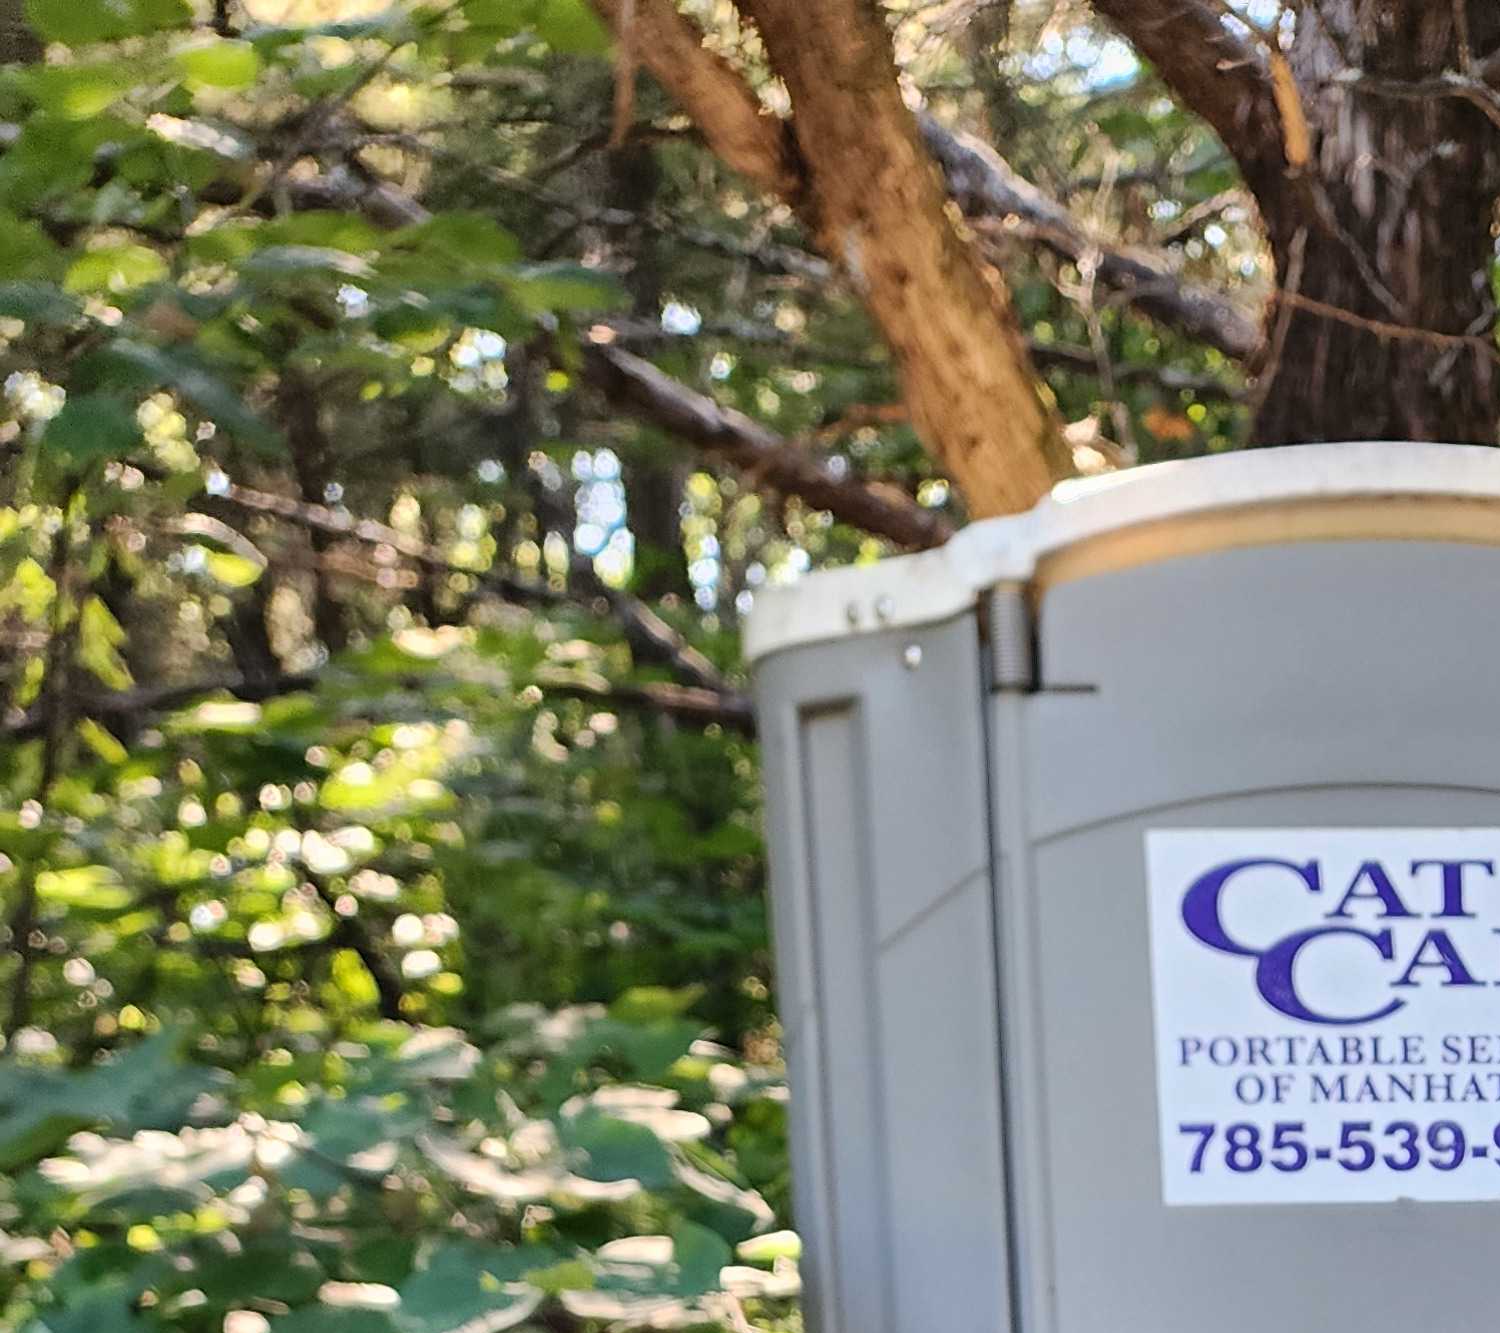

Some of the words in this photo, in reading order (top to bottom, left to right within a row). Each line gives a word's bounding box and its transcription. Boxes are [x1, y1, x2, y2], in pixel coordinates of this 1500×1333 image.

[1180, 857, 1496, 957] CAT
[1178, 1035, 1426, 1068] PORTABLE
[1234, 1076, 1295, 1105] OF
